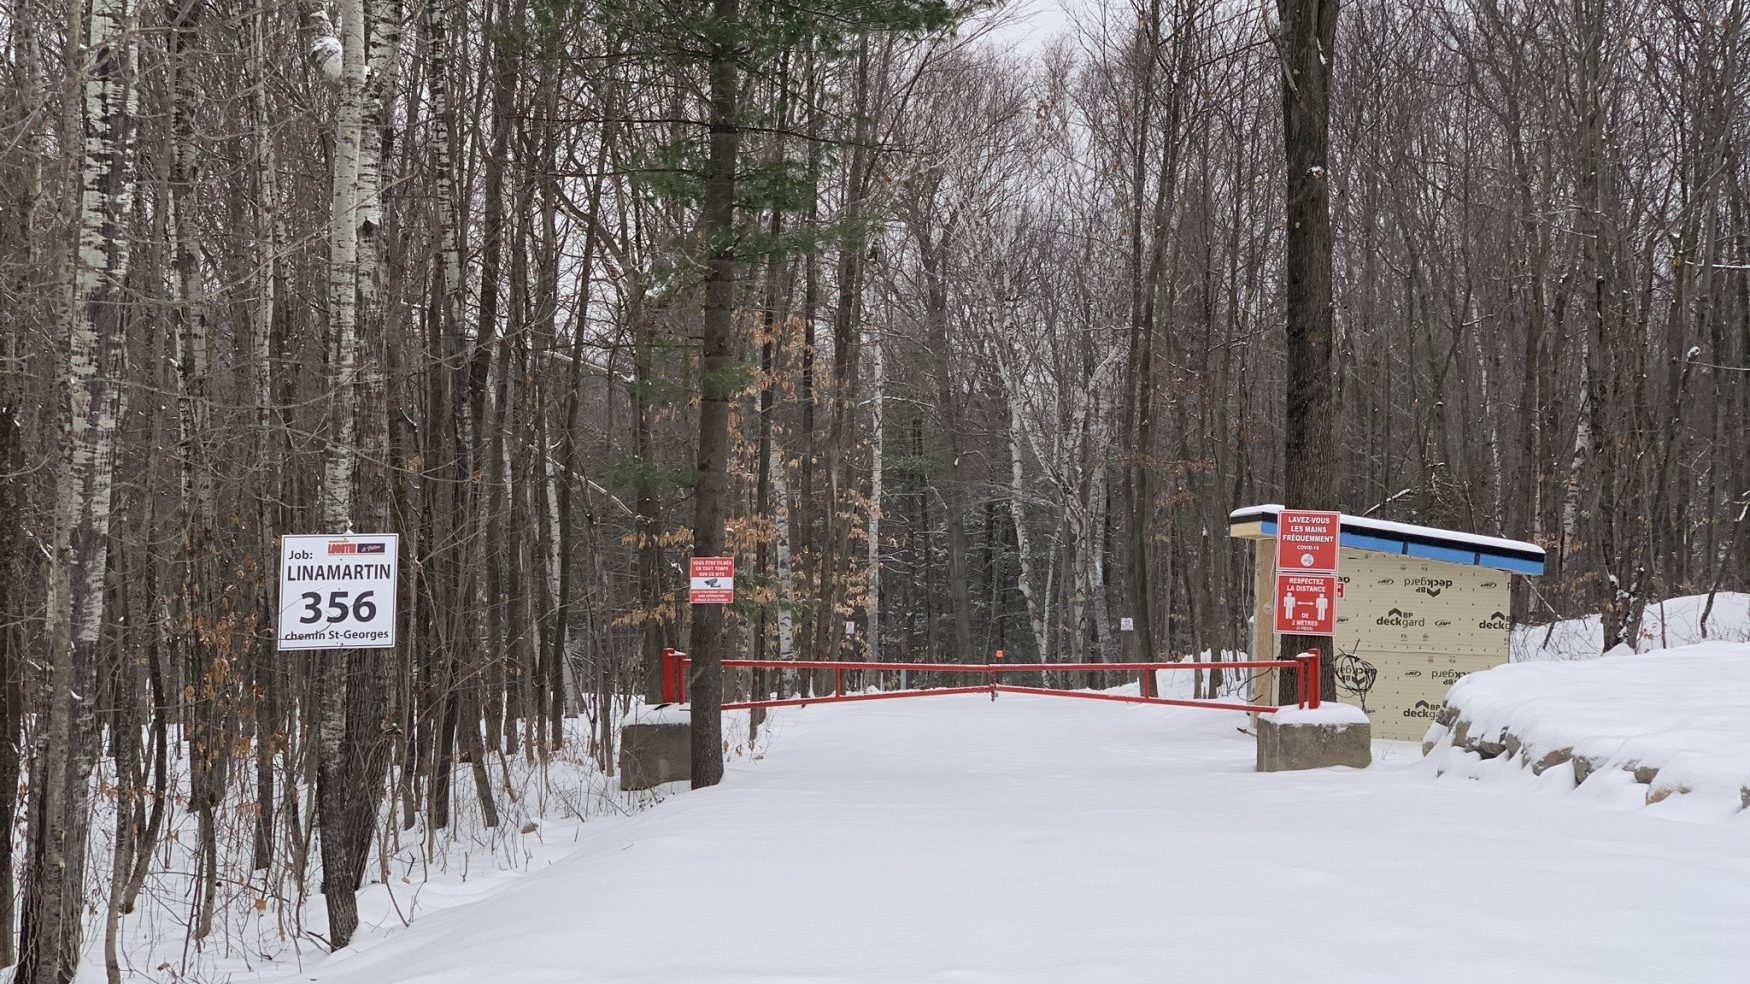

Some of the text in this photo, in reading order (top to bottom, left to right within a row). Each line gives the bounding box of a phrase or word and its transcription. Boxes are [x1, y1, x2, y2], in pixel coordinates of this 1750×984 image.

[1288, 516, 1330, 524] LAVEZ-VOUS
[1282, 533, 1334, 543] FRÉQUEMMENT
[288, 550, 313, 560] Job:
[287, 564, 391, 581] LINAMARTIN
[1288, 577, 1325, 585] RESPECTEZ
[1404, 577, 1453, 588] deckgard
[1295, 585, 1326, 593] DISTANCE
[299, 590, 377, 624] 356
[1376, 616, 1425, 628] deckgard
[1479, 620, 1511, 632] deckg
[284, 630, 389, 641] chemin St-Georges
[1403, 708, 1437, 721] deckg
